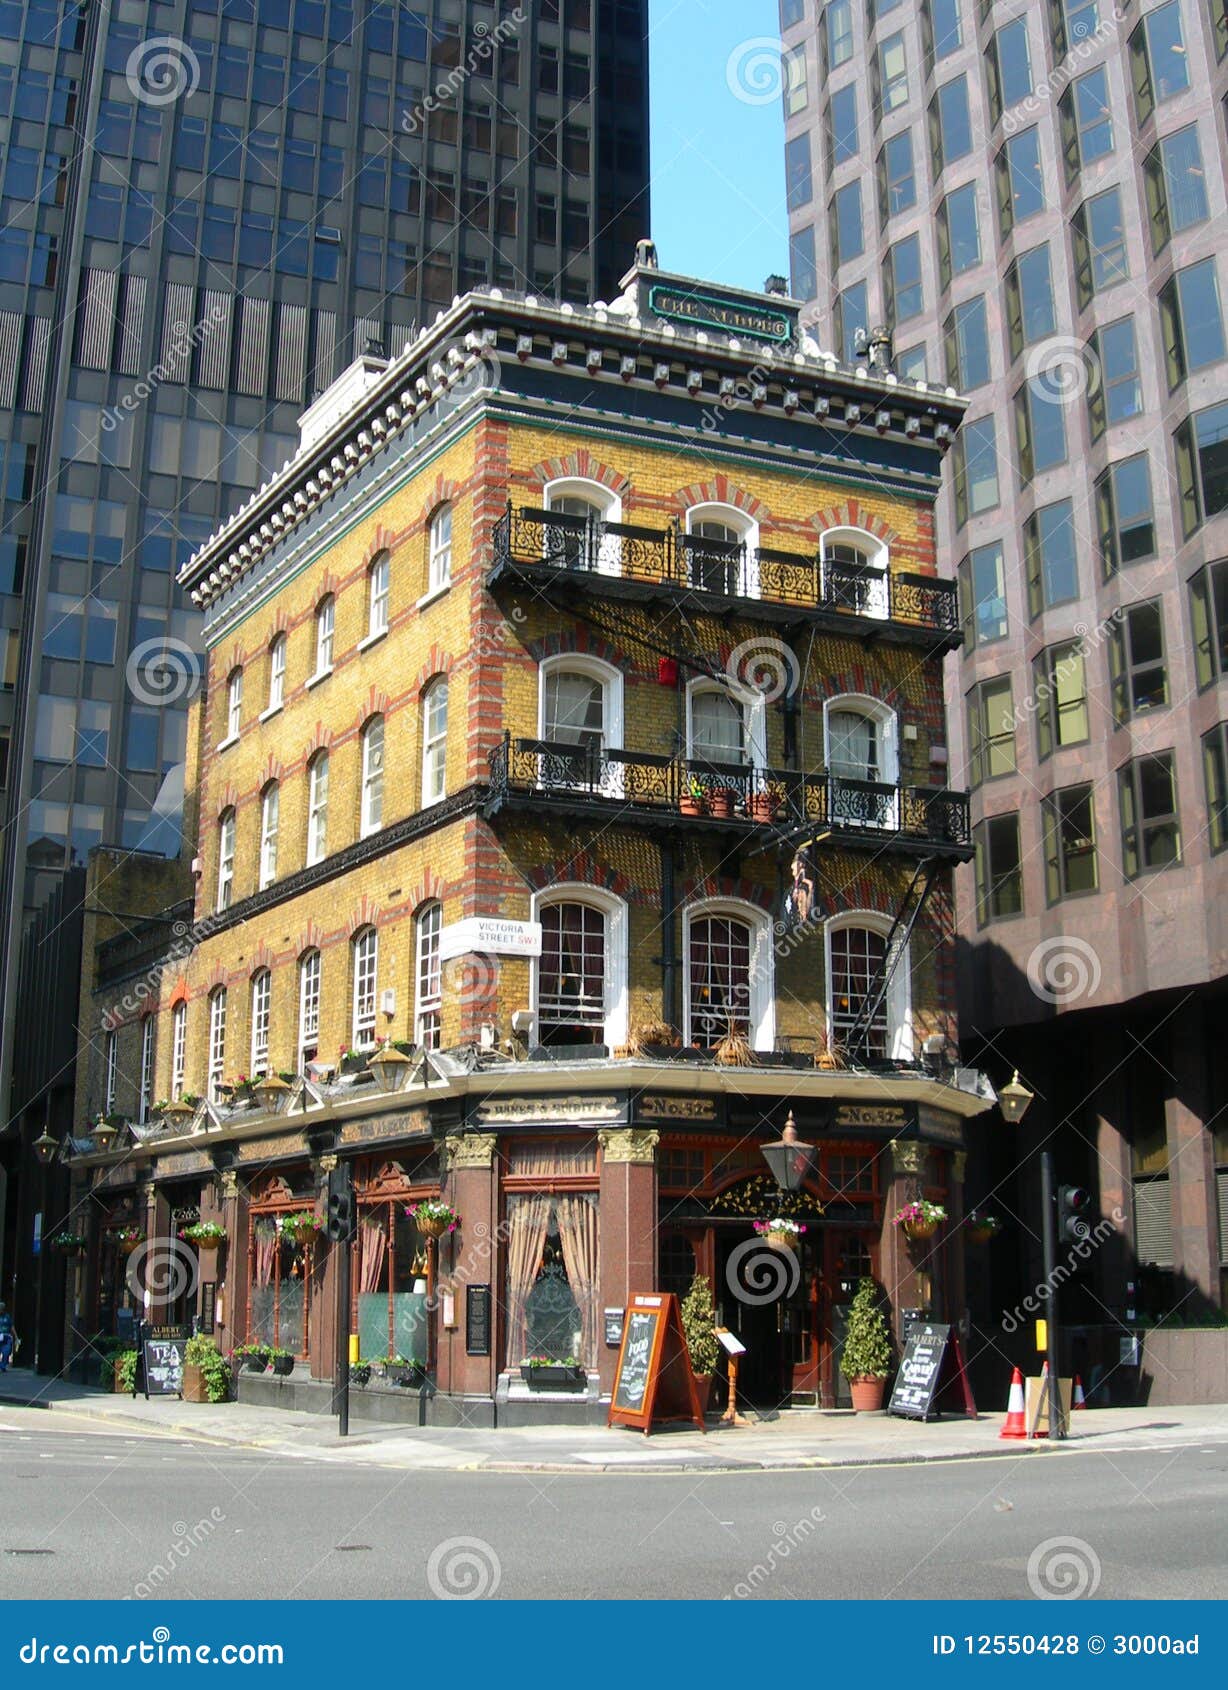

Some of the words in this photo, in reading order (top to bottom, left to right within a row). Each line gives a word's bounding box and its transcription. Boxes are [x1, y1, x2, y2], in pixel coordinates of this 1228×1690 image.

[479, 922, 523, 933] VICTORIA
[479, 933, 514, 943] STREET
[152, 1345, 180, 1360] TEA
